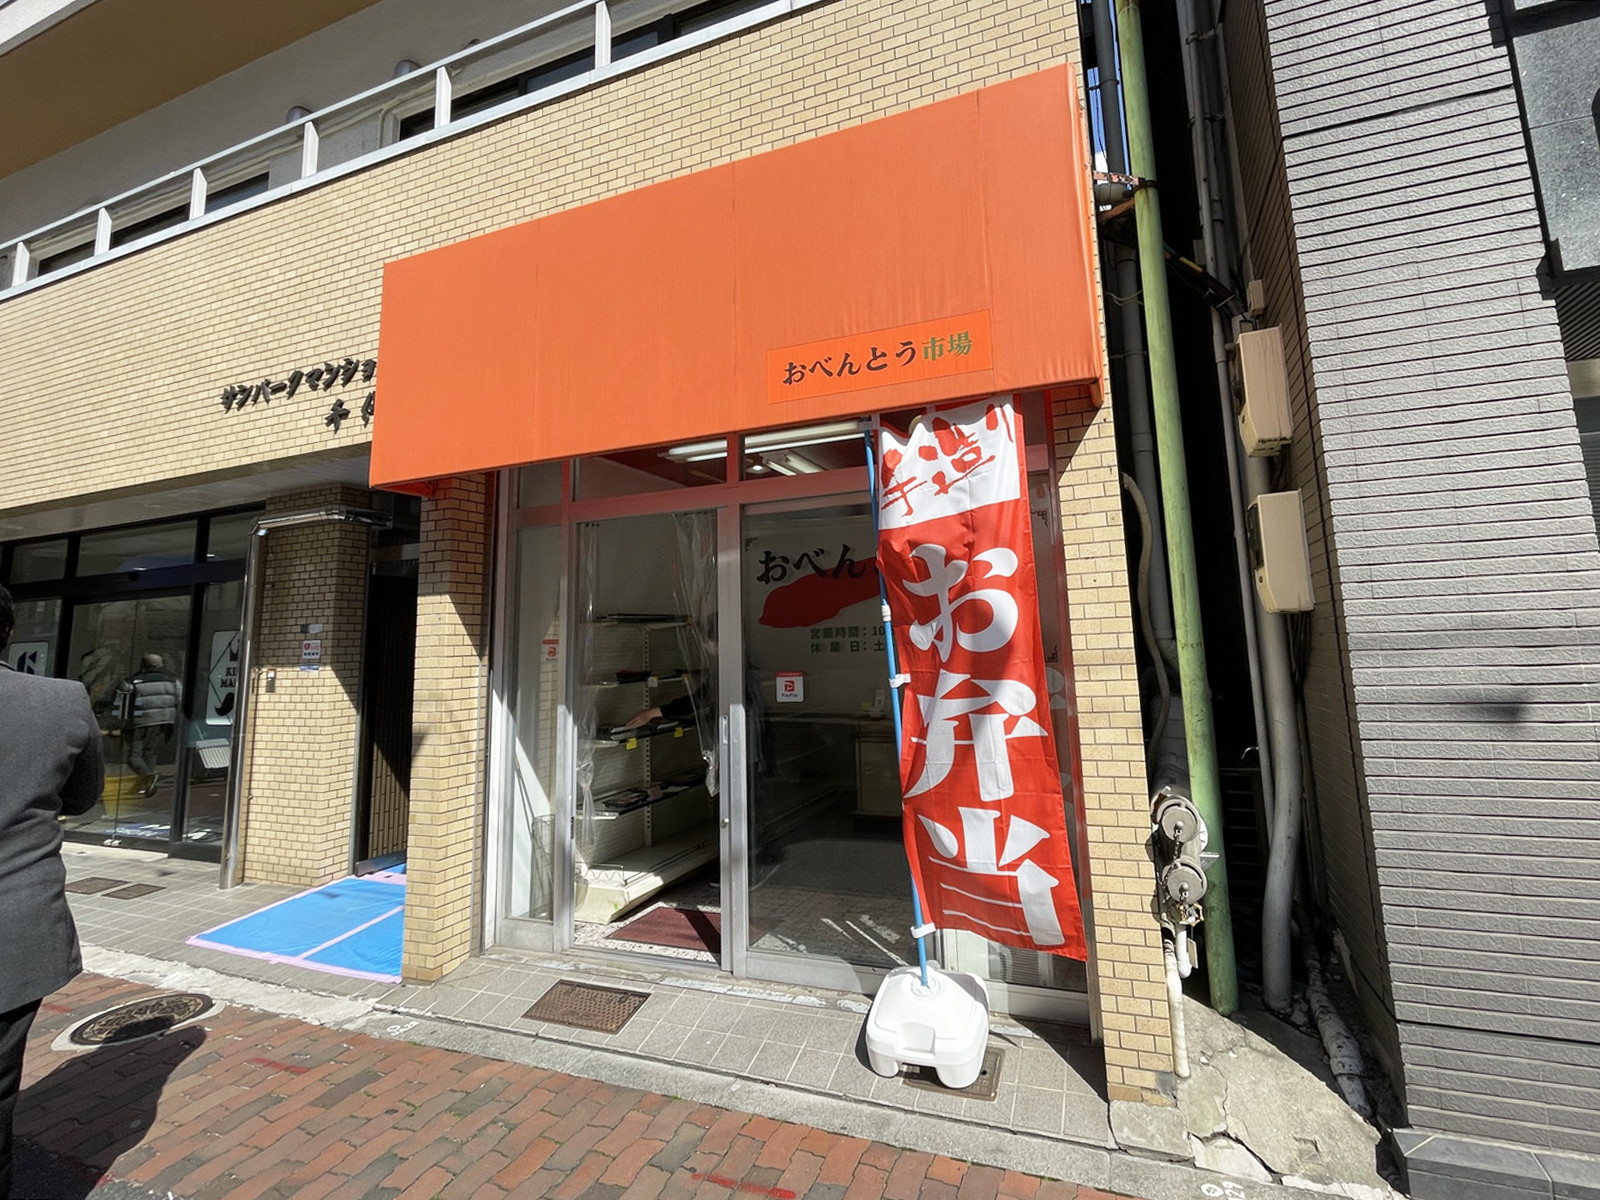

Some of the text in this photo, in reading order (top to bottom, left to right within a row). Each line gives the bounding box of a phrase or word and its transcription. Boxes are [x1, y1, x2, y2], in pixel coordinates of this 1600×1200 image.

[782, 331, 972, 386] おべんとう市場
[757, 544, 881, 584] おべん
[902, 543, 1066, 946] お弁当
